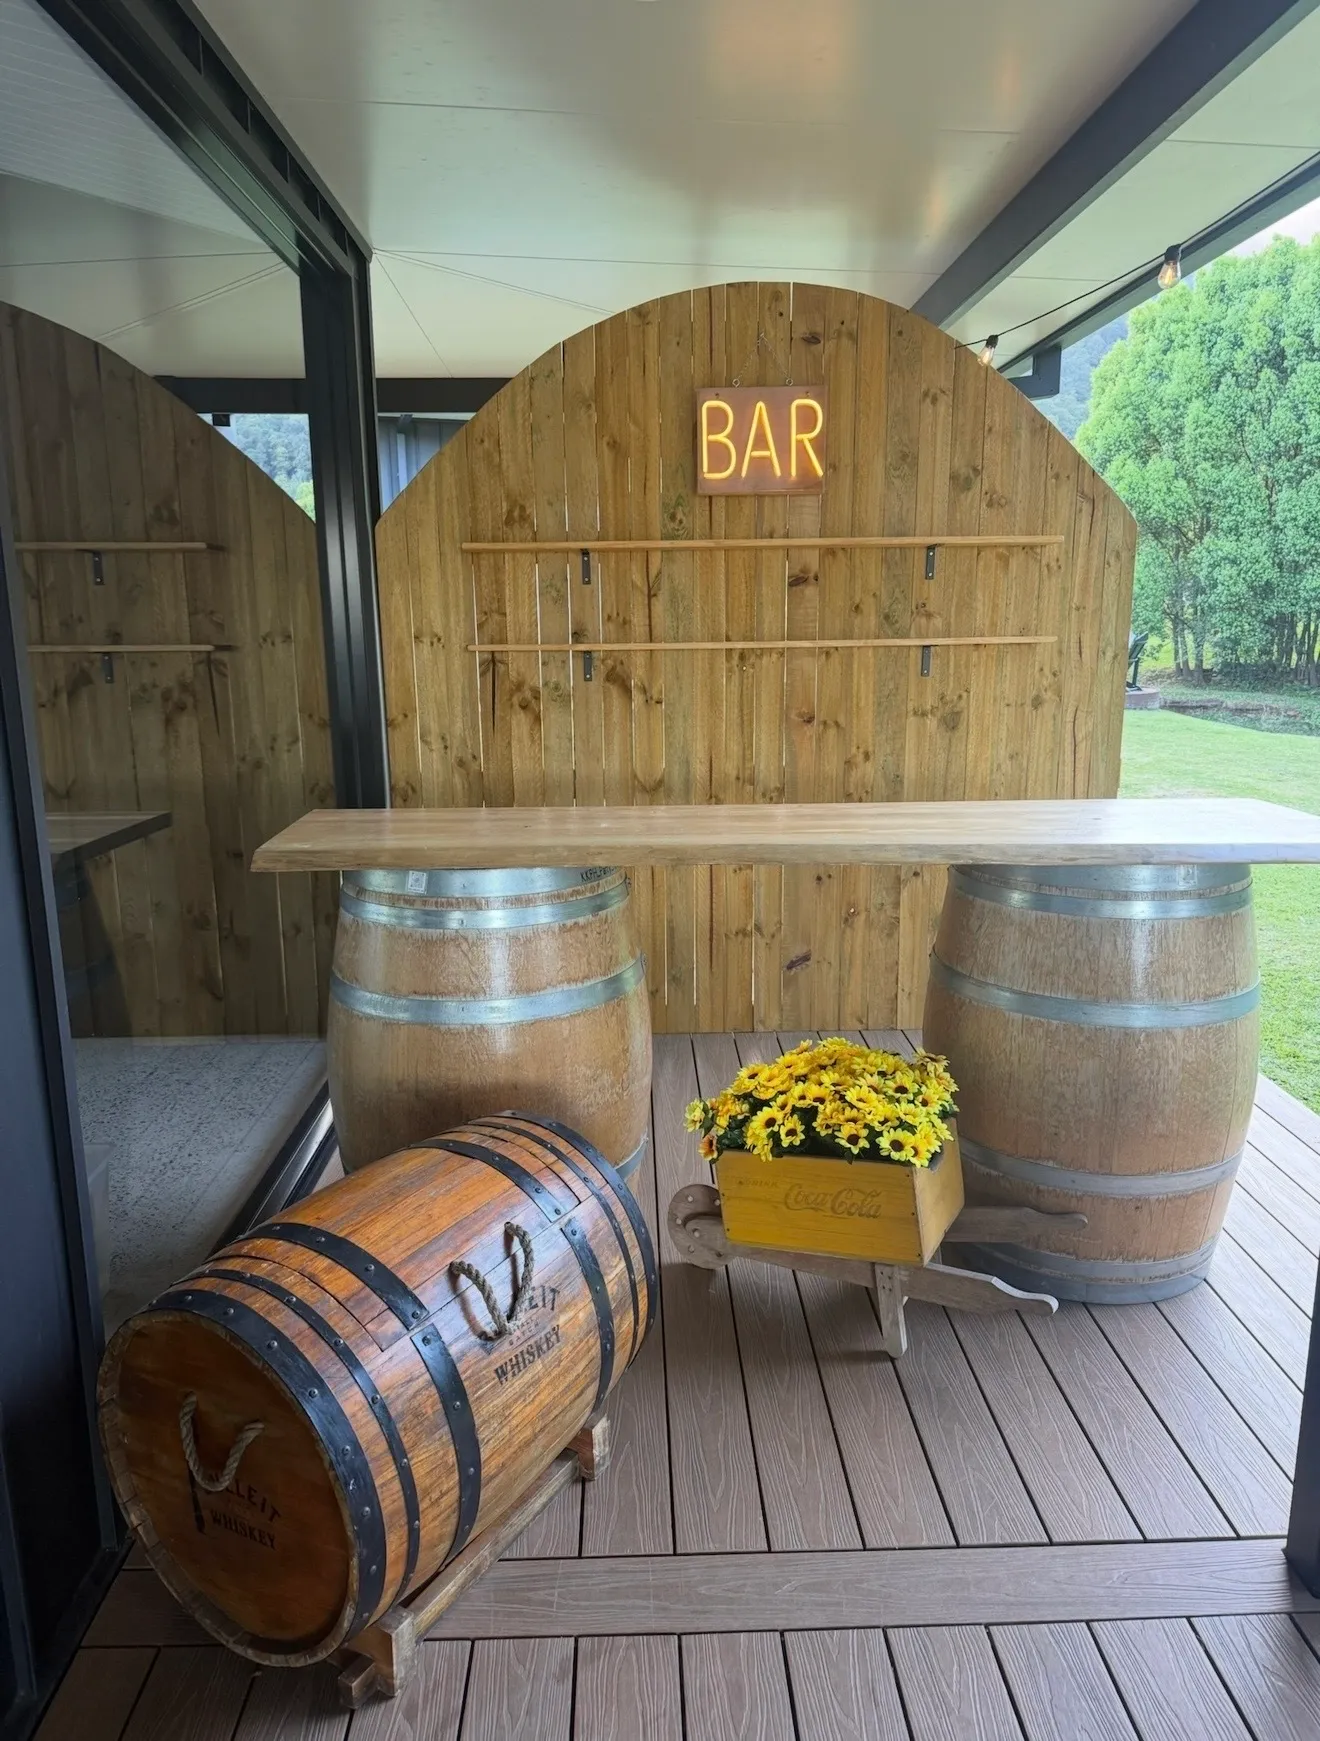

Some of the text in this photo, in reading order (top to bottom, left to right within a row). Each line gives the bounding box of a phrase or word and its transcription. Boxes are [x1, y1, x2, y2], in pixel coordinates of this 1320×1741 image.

[702, 399, 823, 480] BAR
[494, 1324, 561, 1385] WHISKEY
[210, 1509, 277, 1549] WHISKEY
